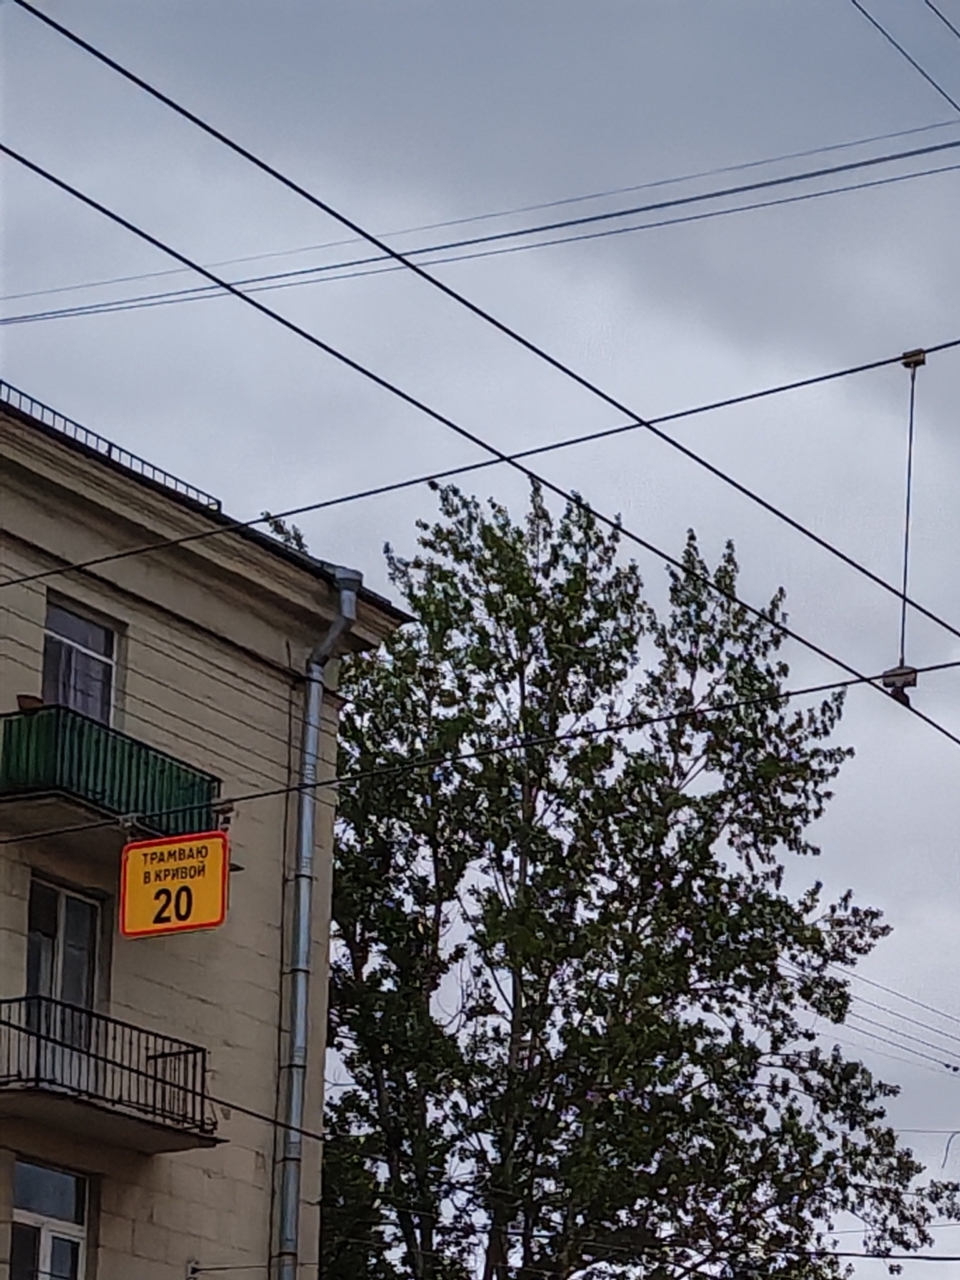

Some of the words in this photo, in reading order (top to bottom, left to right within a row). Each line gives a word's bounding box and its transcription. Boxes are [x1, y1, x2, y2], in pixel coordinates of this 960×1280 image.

[142, 845, 208, 866] ТРАМВАЮ
[143, 870, 151, 884] В
[154, 861, 206, 882] КРИВОЙ
[152, 885, 193, 924] 20
